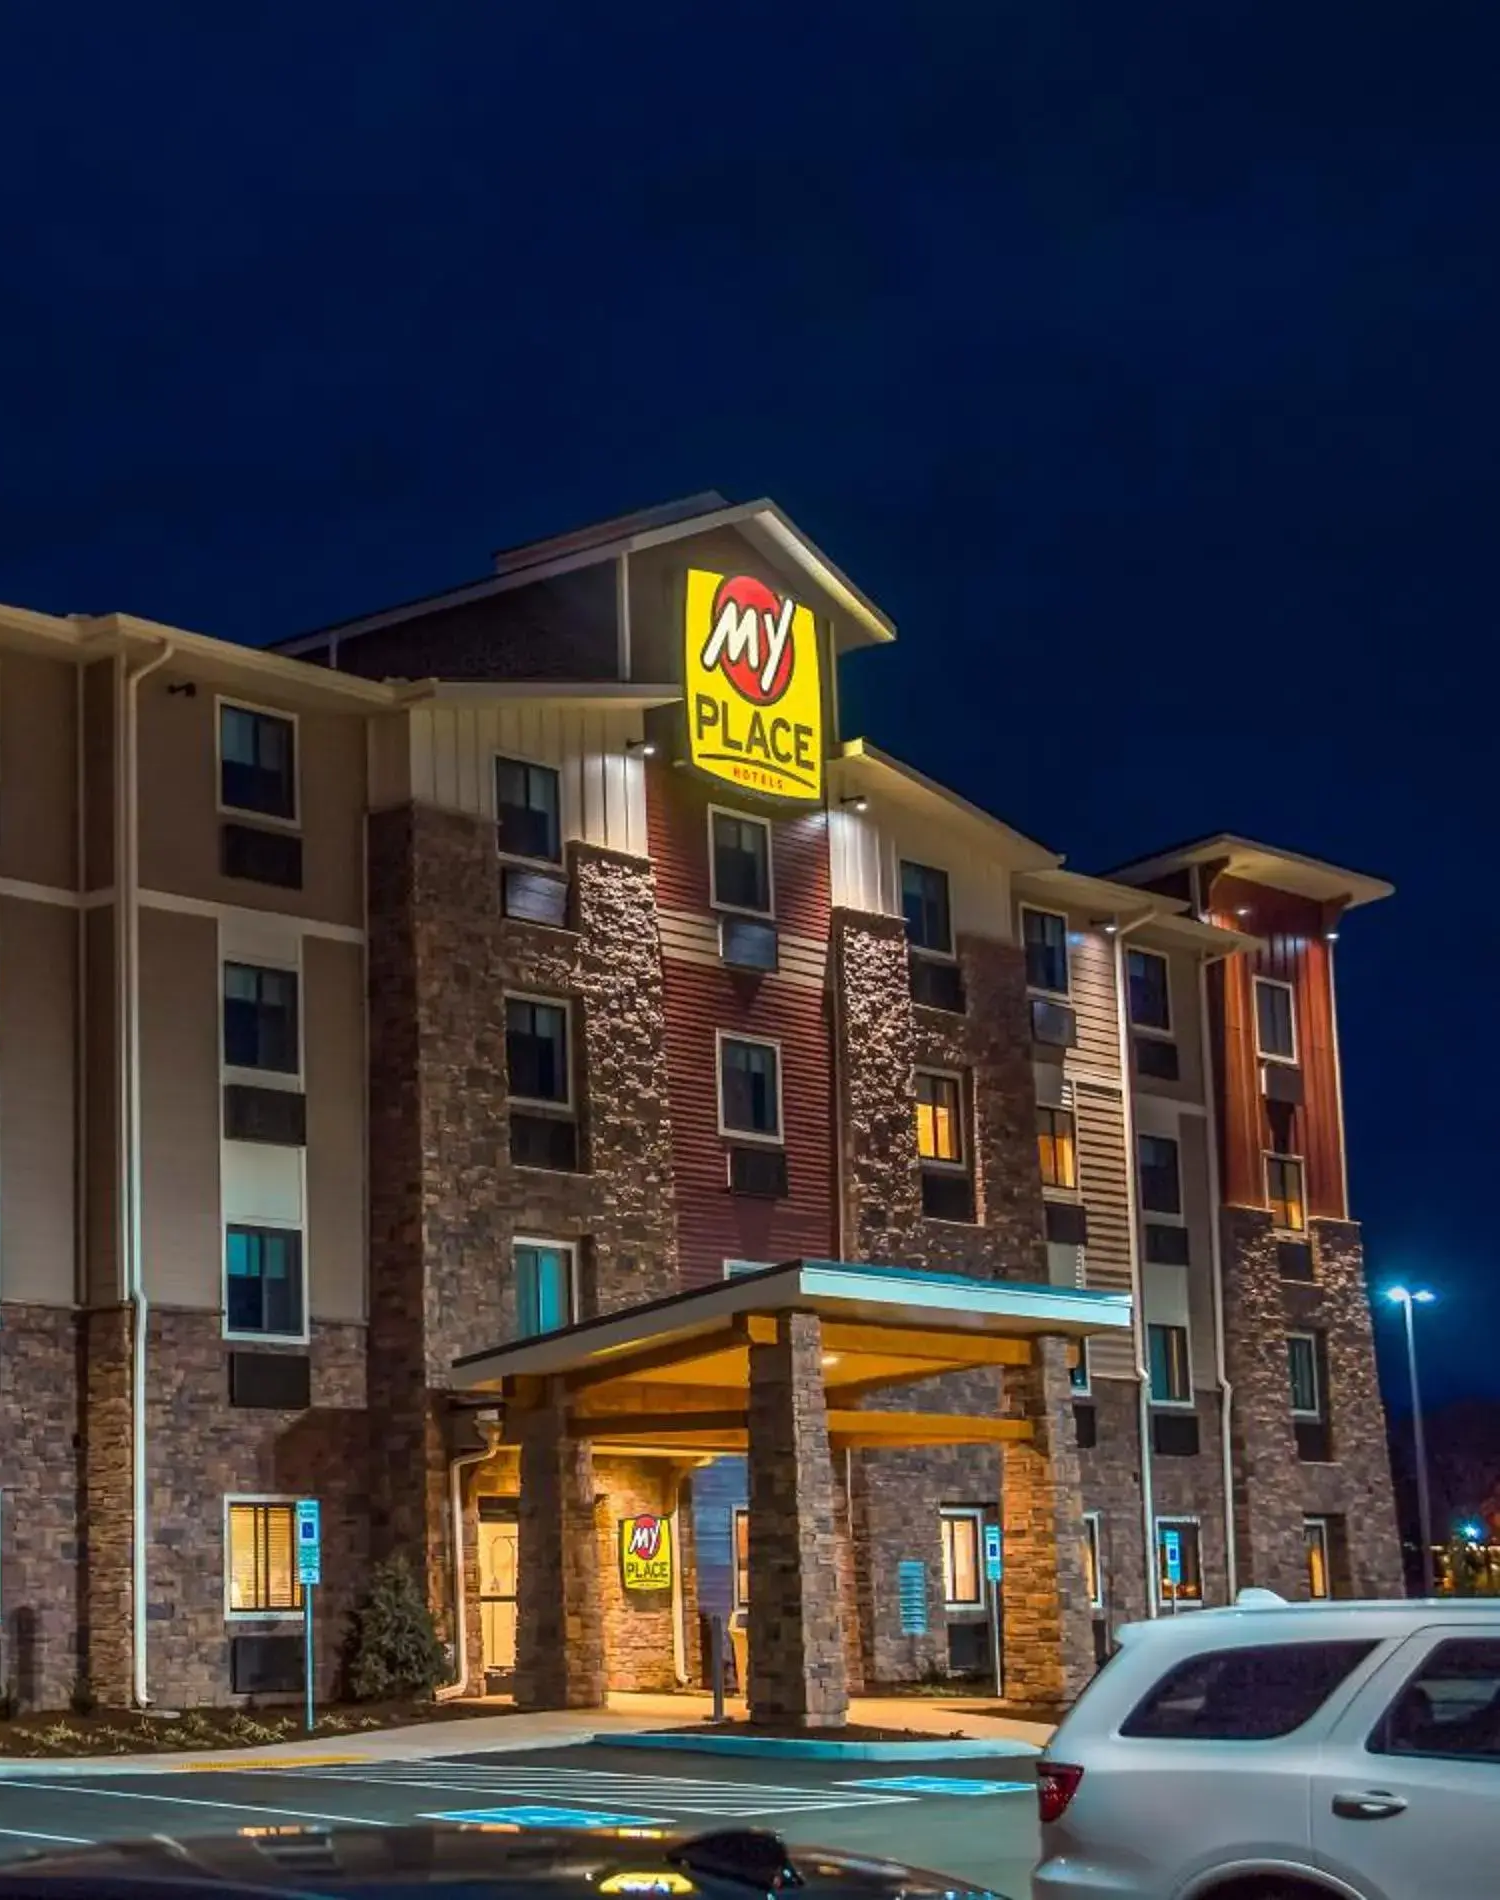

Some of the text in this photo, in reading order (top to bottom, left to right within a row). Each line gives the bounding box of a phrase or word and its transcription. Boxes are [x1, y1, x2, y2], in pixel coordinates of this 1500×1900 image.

[695, 693, 815, 771] PLACE
[733, 767, 784, 791] HOTELS
[626, 1562, 669, 1578] PLACE
